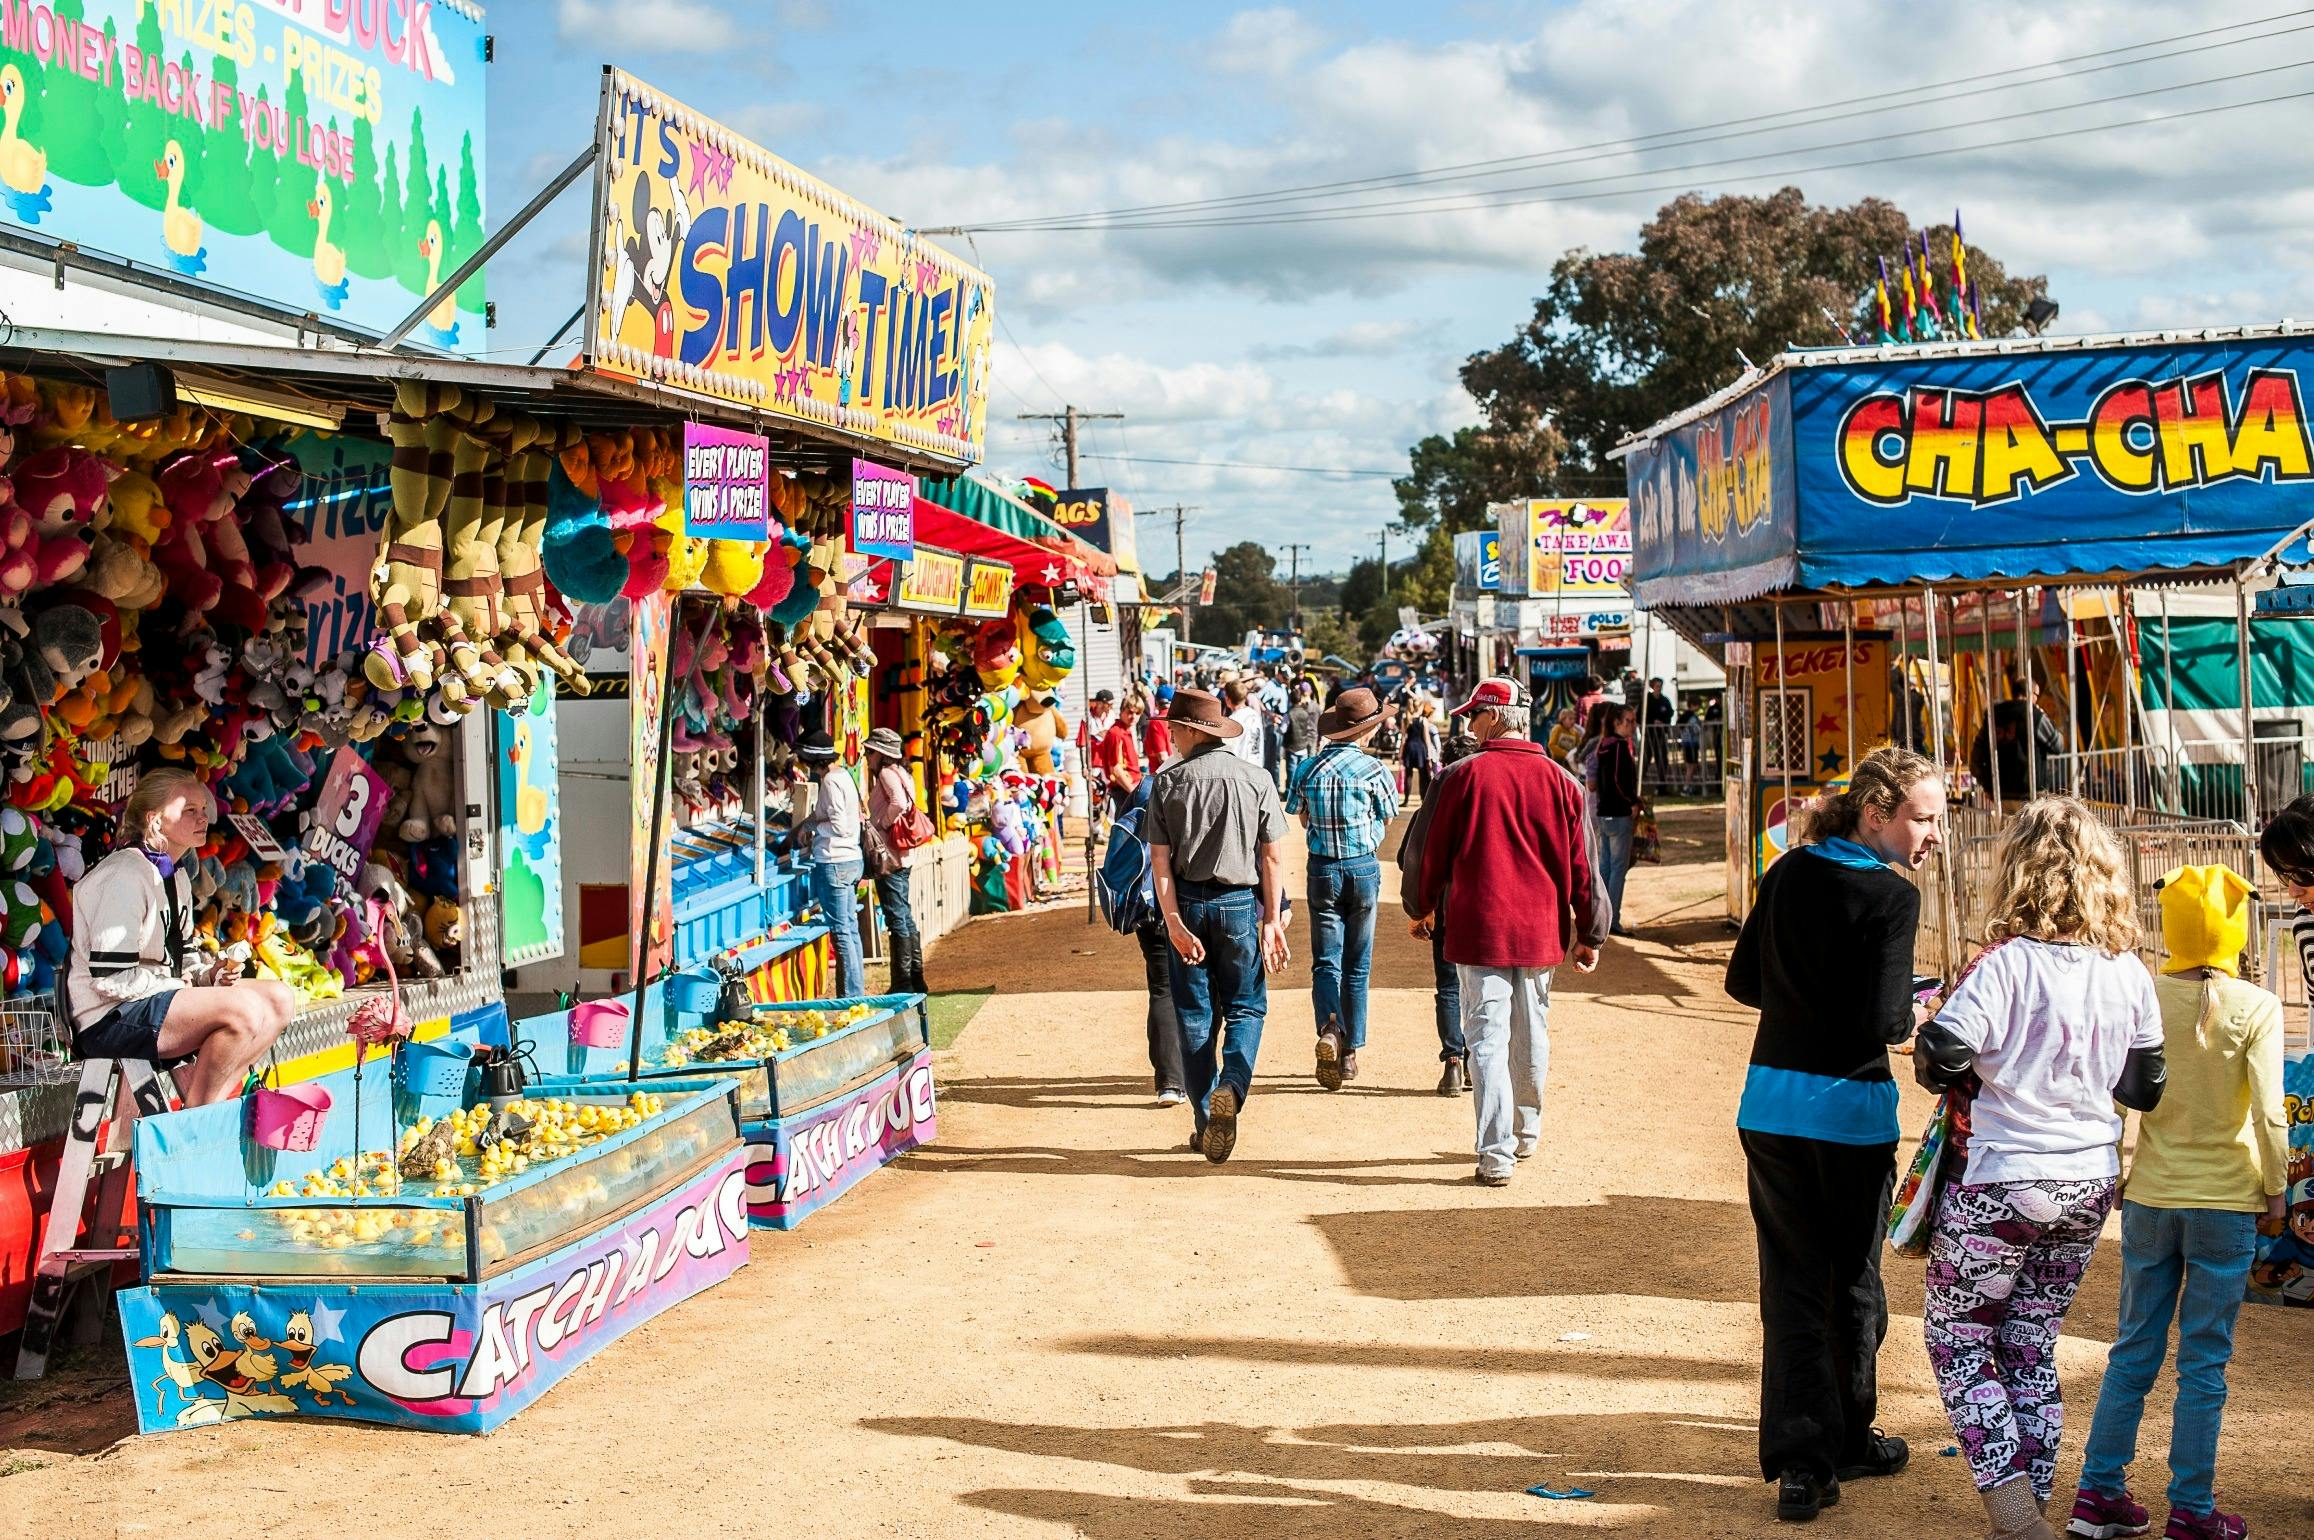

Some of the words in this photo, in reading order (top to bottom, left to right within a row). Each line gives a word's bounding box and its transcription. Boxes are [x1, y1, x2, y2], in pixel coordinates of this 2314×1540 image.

[2, 0, 117, 88] MONEY
[125, 43, 203, 123] BACK
[209, 79, 233, 133] IF
[238, 91, 290, 157] YOU
[296, 116, 356, 183] LOSE
[283, 25, 382, 126] PRIZES
[680, 203, 848, 368] SHOW
[1836, 366, 2314, 509] CHA-CHA
[687, 445, 725, 482] EVERY
[725, 445, 764, 482] PLAYER
[288, 446, 392, 543] rize
[690, 485, 719, 523] WINS
[720, 484, 729, 522] A
[855, 478, 883, 508] EVERY
[882, 480, 911, 511] PLAYER
[857, 512, 879, 543] WINS
[878, 512, 886, 543] A
[1541, 534, 1589, 550] TAKE
[916, 557, 958, 599] LAUGHING
[1568, 559, 1630, 580] FOO
[1588, 613, 1623, 631] COLD
[1760, 642, 1873, 682] TICKETS
[335, 773, 370, 838] 3
[309, 825, 361, 877] DUCKS
[845, 1101, 870, 1161] A
[355, 1248, 624, 1402] CATCH
[612, 1227, 661, 1309] A
[2005, 1320, 2044, 1337] WHAT
[1971, 1441, 2016, 1466] CRAY!
